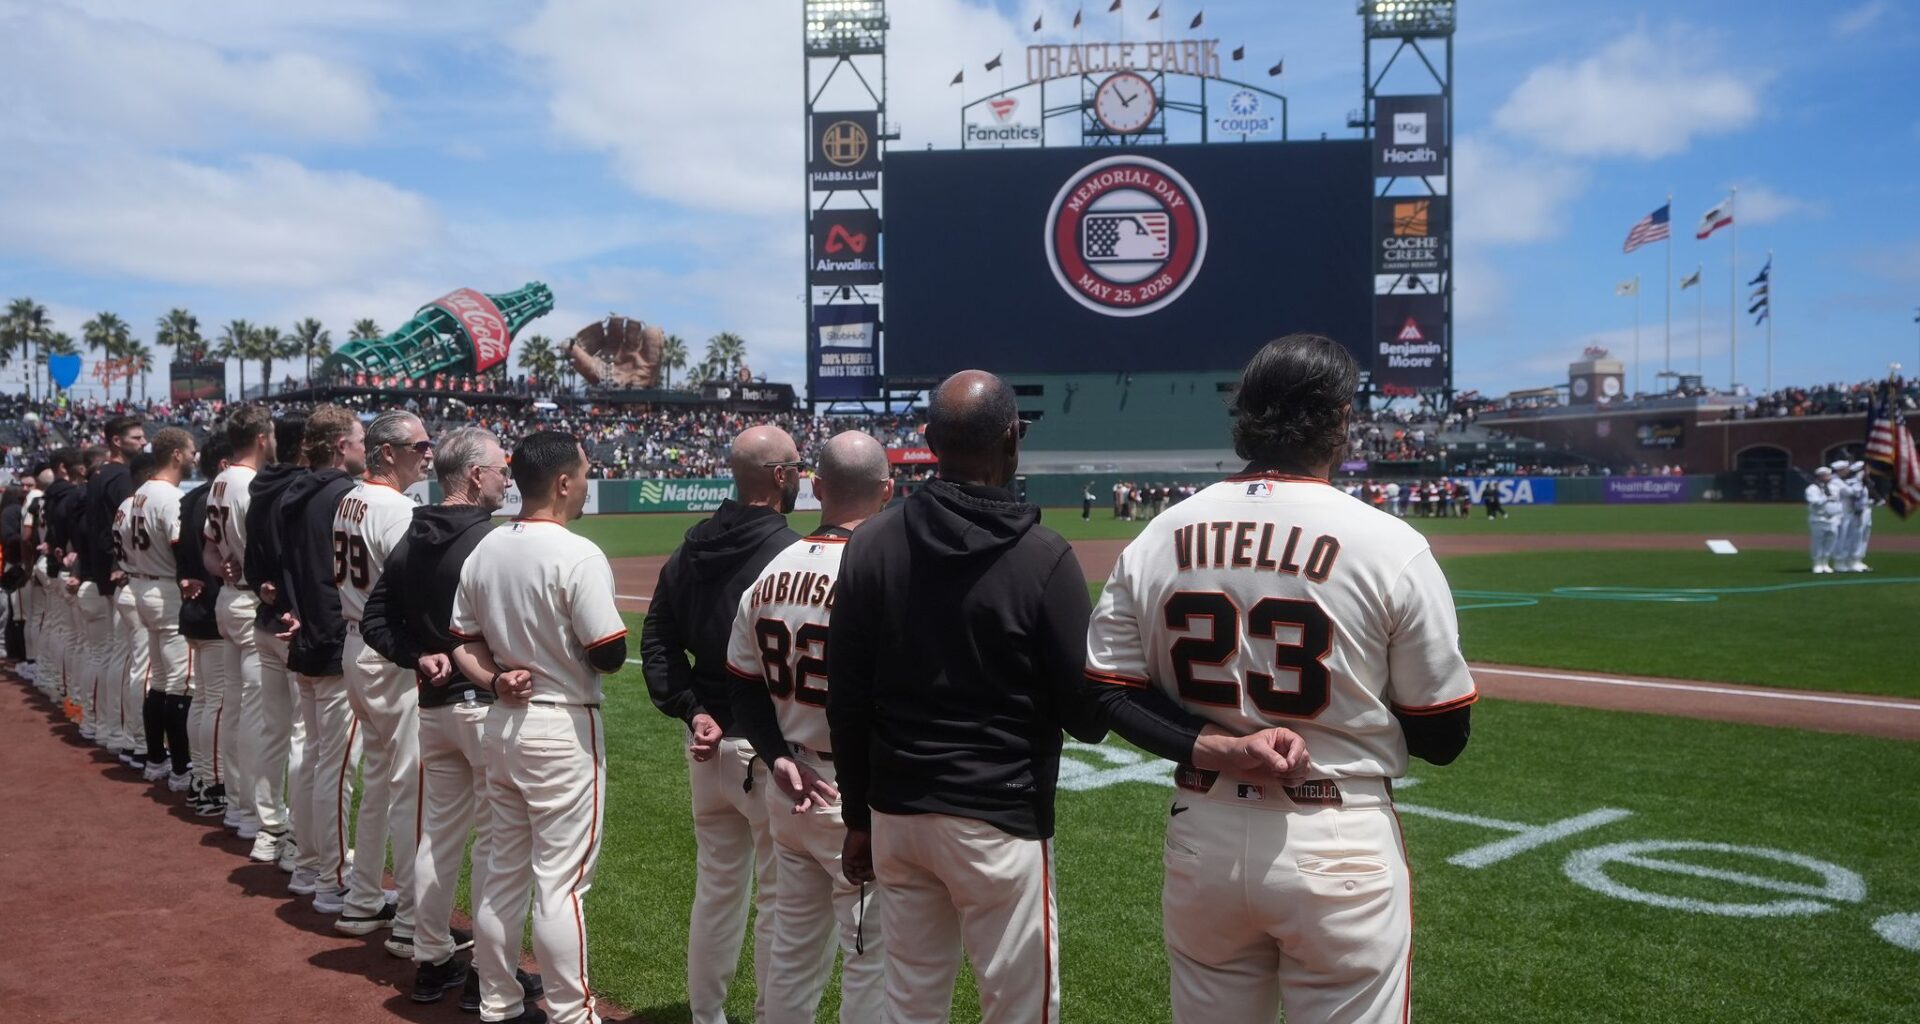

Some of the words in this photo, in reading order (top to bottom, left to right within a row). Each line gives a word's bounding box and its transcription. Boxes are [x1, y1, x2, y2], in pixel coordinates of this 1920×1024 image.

[1027, 42, 1135, 84] ORACLE
[1147, 38, 1221, 80] PARK
[1221, 116, 1269, 134] coupa
[967, 125, 1039, 141] Fanatics
[1383, 148, 1437, 163] Health
[814, 171, 854, 182] HABBAS
[855, 170, 877, 181] LAW
[1068, 170, 1150, 212] MEMORIAL
[1154, 180, 1184, 209] DAY
[1382, 237, 1438, 249] CACHE
[1384, 249, 1436, 261] CREEK
[816, 258, 876, 272] Airwallex
[1078, 274, 1111, 300] MAY
[1114, 289, 1136, 304] 25,
[1140, 274, 1173, 300] 2026
[826, 330, 866, 341] StubHub
[1379, 342, 1441, 357] Benjamin
[821, 353, 840, 365] 100%
[841, 352, 873, 364] VERIFIED
[1388, 355, 1432, 368] Moore
[819, 365, 845, 377] GIANTS
[846, 365, 875, 377] TICKETS
[903, 451, 932, 460] Adobe
[663, 483, 735, 502] National
[1610, 480, 1682, 494] HealthEquity
[687, 502, 703, 512] Car
[1174, 520, 1342, 585] VITELLO
[1163, 590, 1336, 720] 23
[754, 617, 829, 709] 82
[1184, 771, 1204, 787] TONY
[1293, 785, 1338, 799] VITELLO
